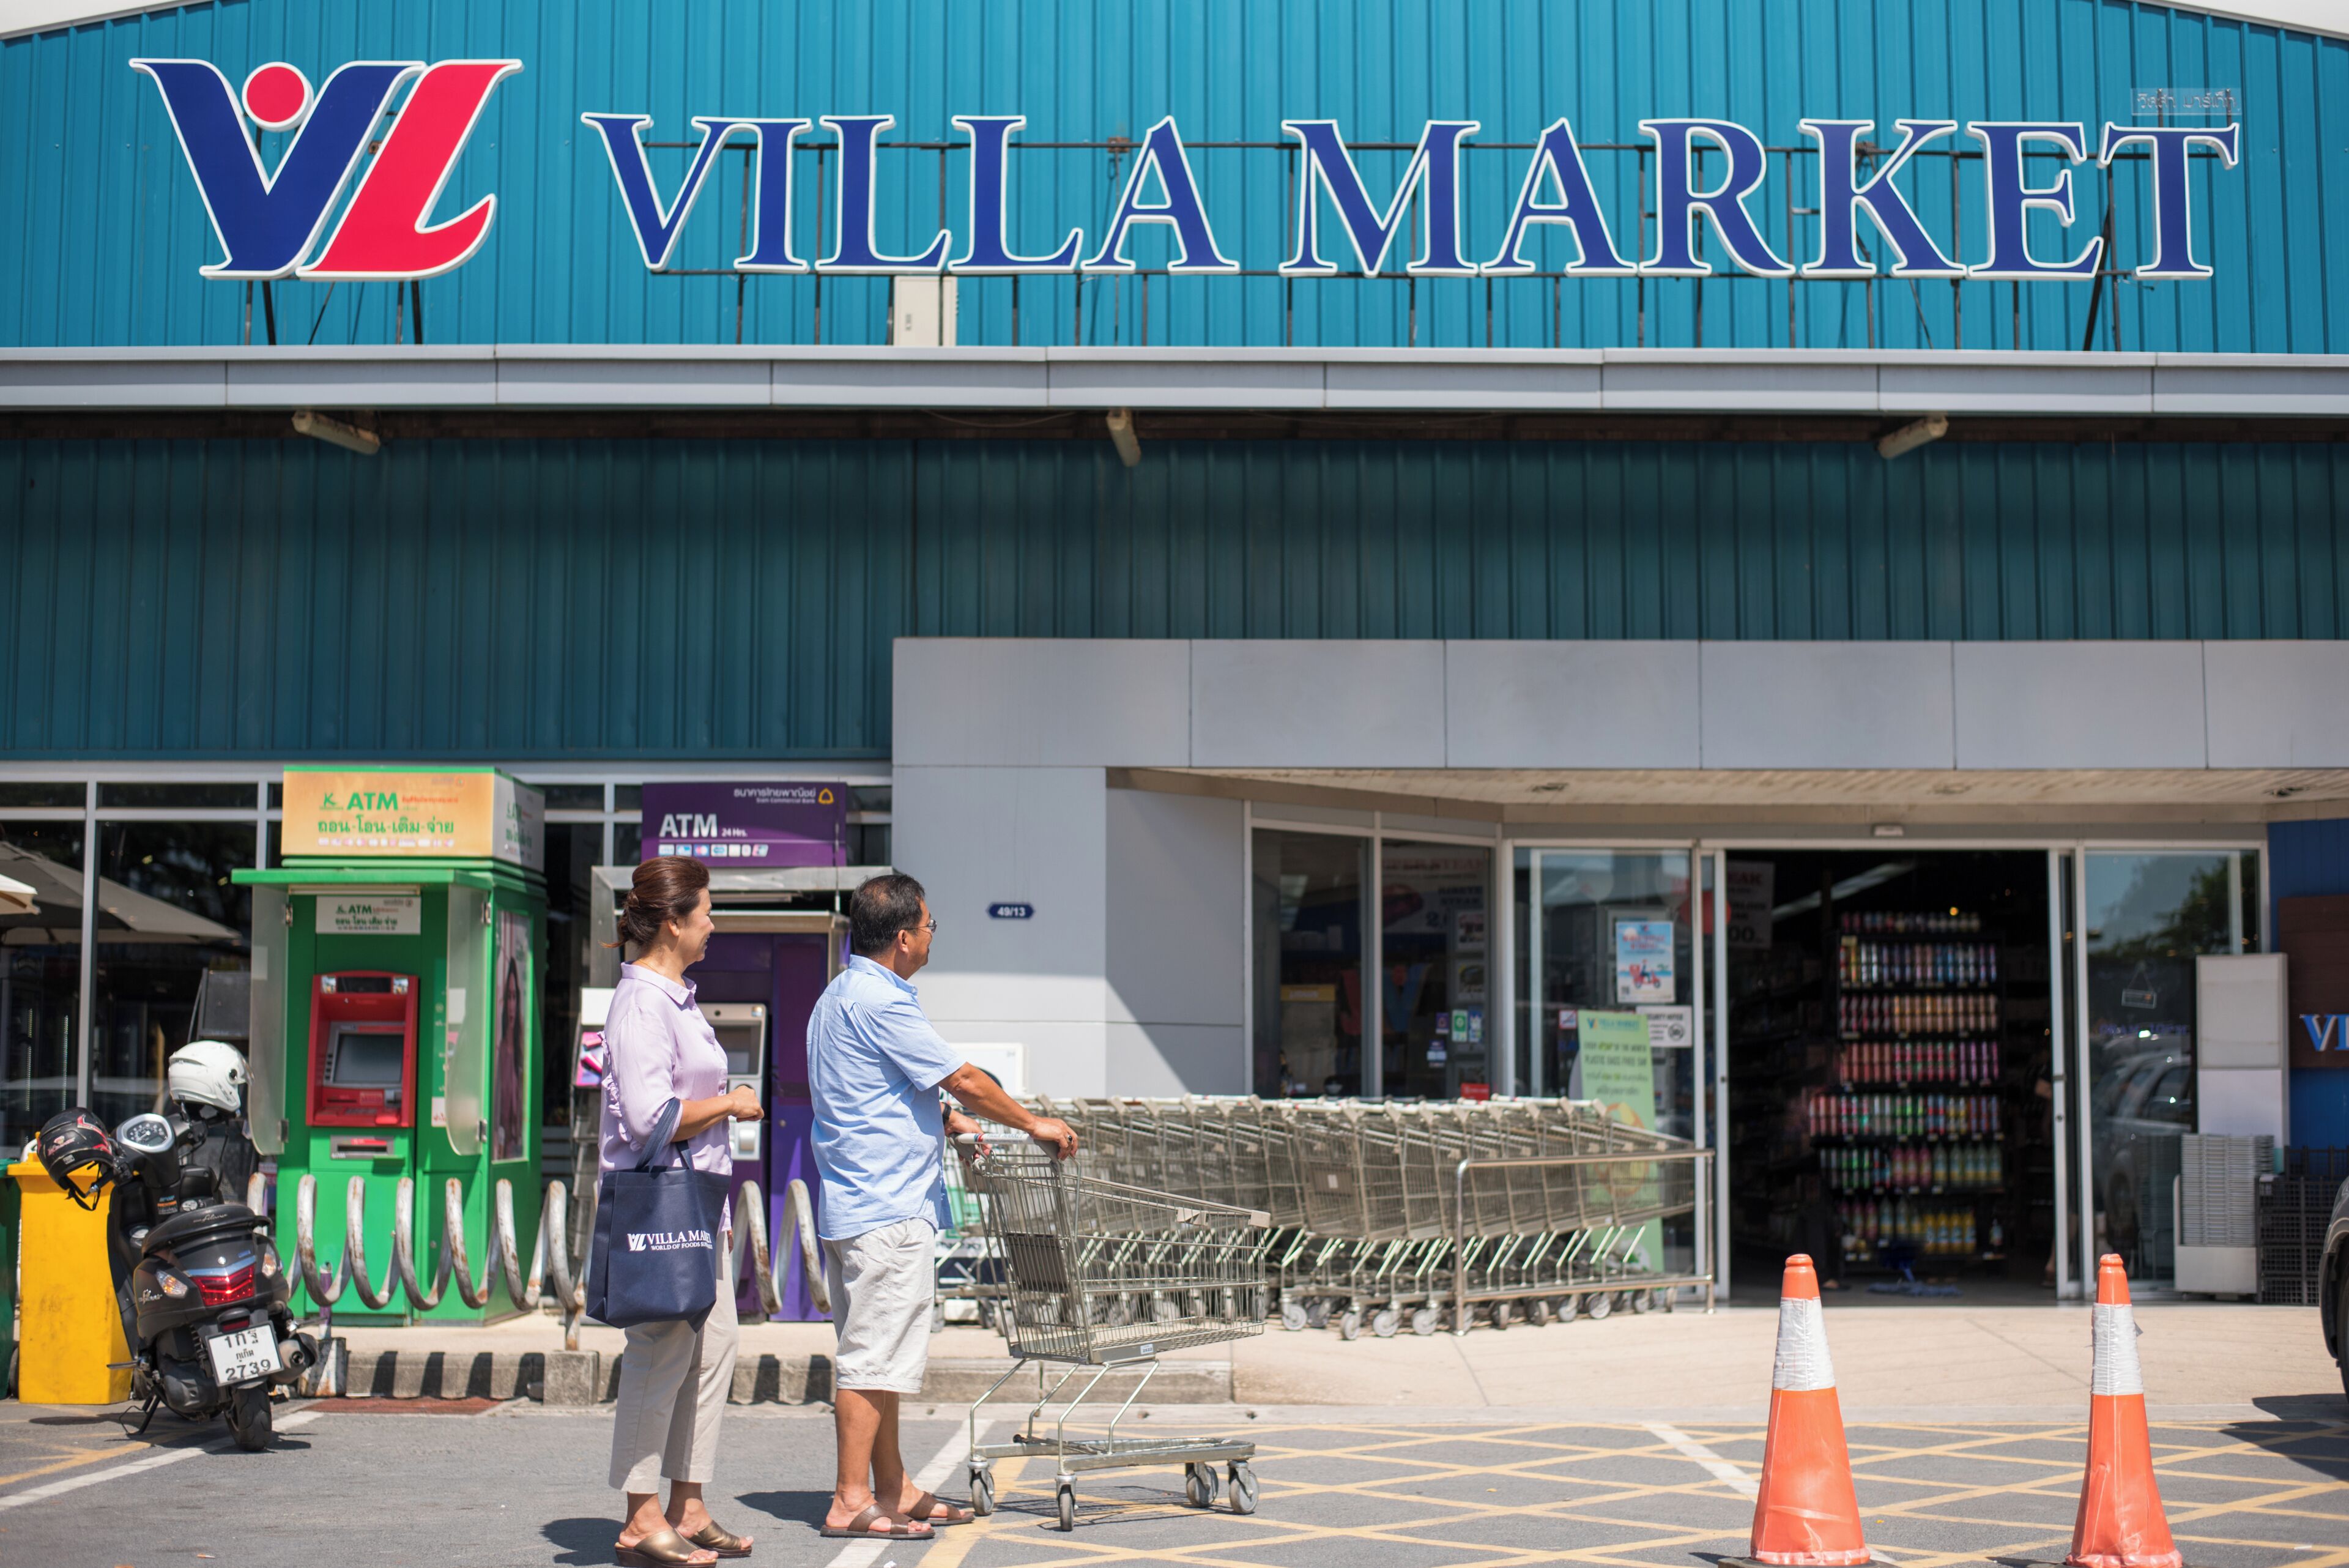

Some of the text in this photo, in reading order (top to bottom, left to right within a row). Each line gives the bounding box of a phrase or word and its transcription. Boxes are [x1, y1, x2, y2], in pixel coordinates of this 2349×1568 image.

[581, 112, 1240, 275] VILLA
[1277, 116, 2241, 282] MARKET
[347, 792, 398, 811] ATM
[659, 814, 748, 838] ATM 24 Hrs.
[348, 904, 372, 914] ATM
[997, 907, 1026, 916] 49/13
[647, 1231, 687, 1244] VILLA
[226, 1359, 271, 1381] 2739
